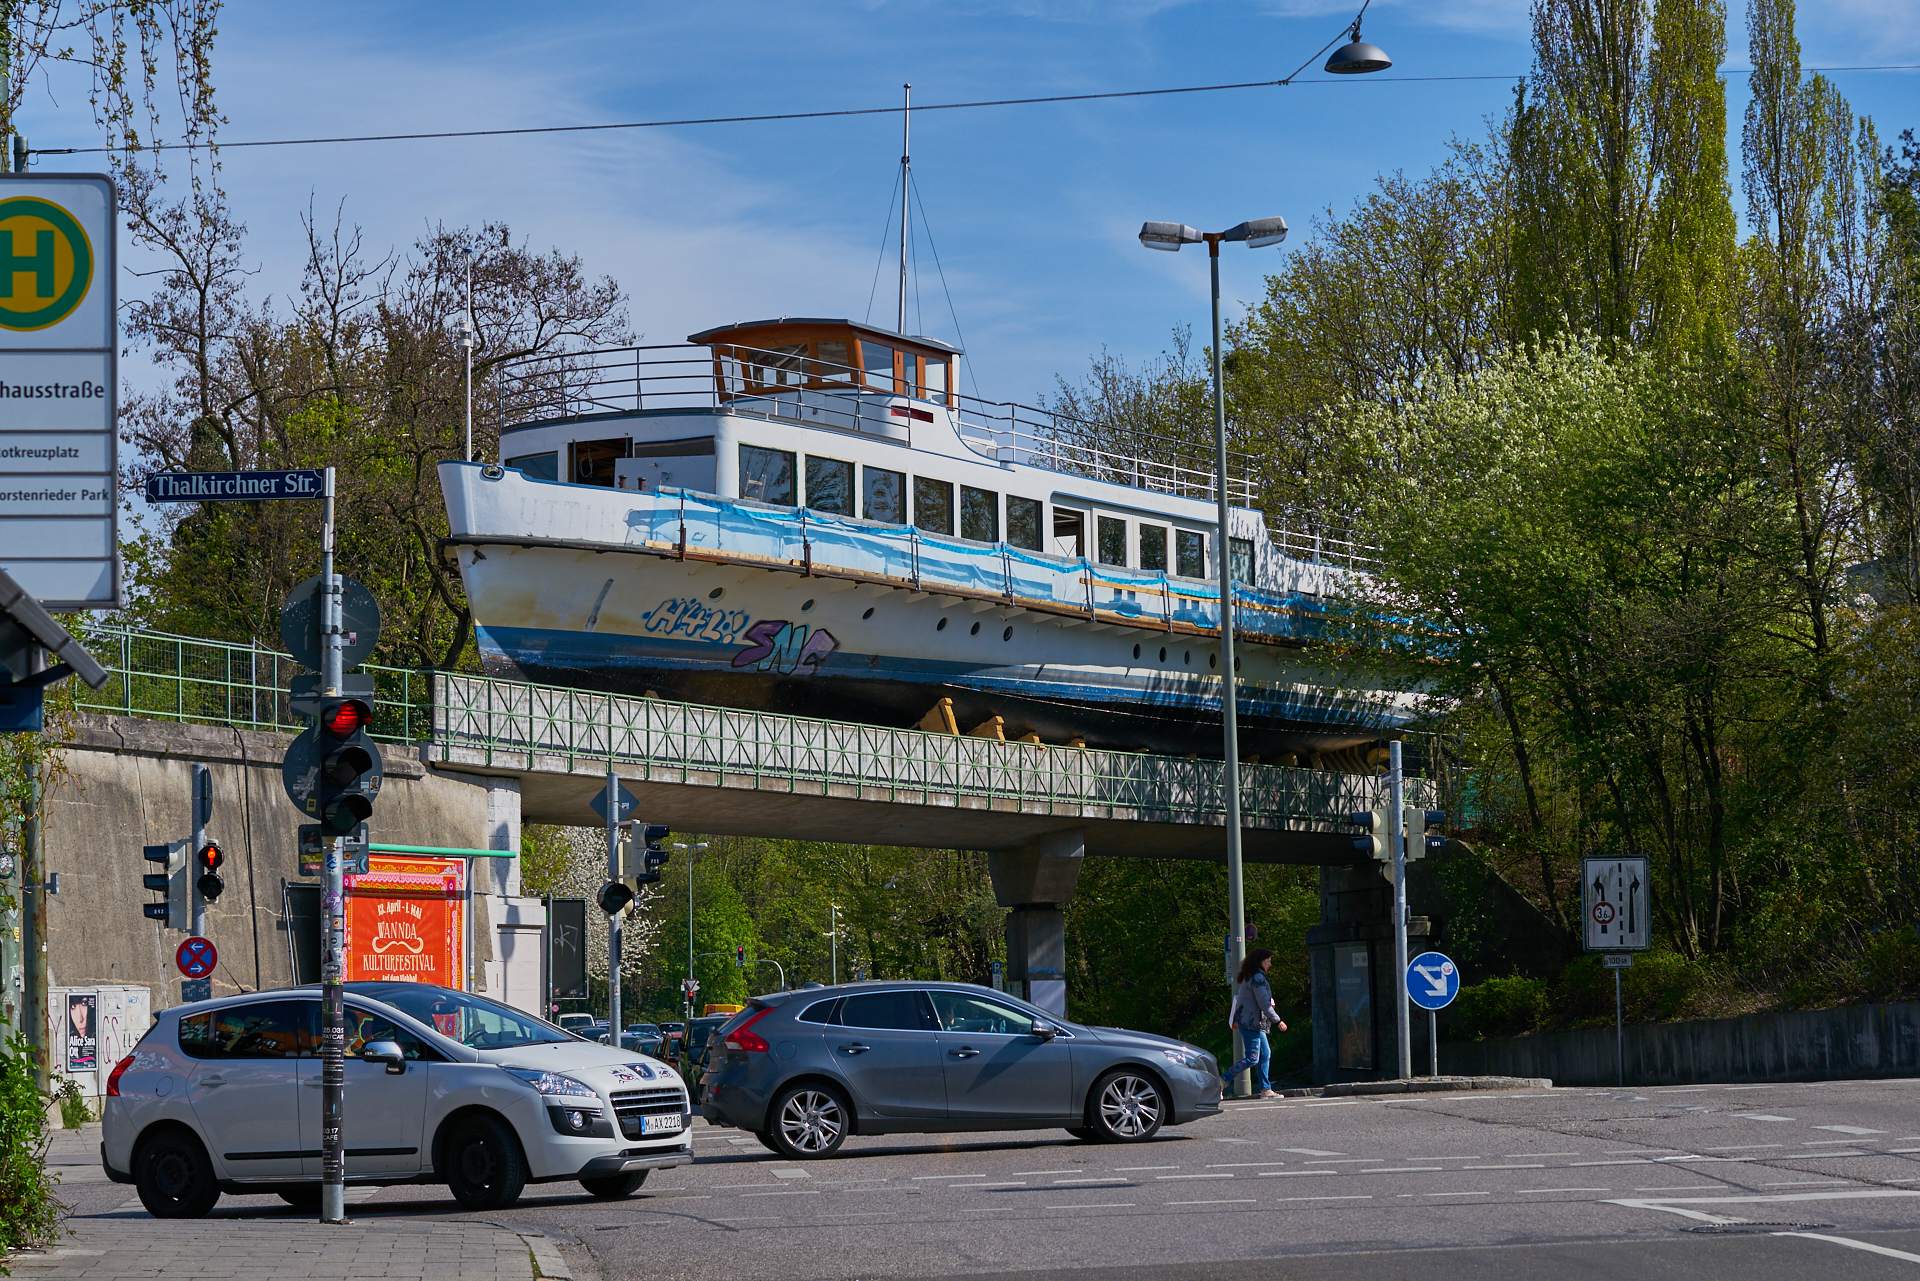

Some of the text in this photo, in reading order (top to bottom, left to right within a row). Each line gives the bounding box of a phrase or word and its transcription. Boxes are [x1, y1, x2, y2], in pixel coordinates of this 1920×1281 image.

[0, 229, 55, 298] H
[0, 380, 105, 399] hausstraße
[0, 446, 80, 461] otkreuzplatz
[155, 472, 316, 497] Thalkirchner Str.
[81, 488, 110, 501] Park
[386, 899, 401, 915] April
[377, 921, 417, 940] WANNDA
[363, 953, 436, 973] KULTURFESTIVAL
[69, 1035, 96, 1047] Alice Sara
[645, 1119, 651, 1131] M
